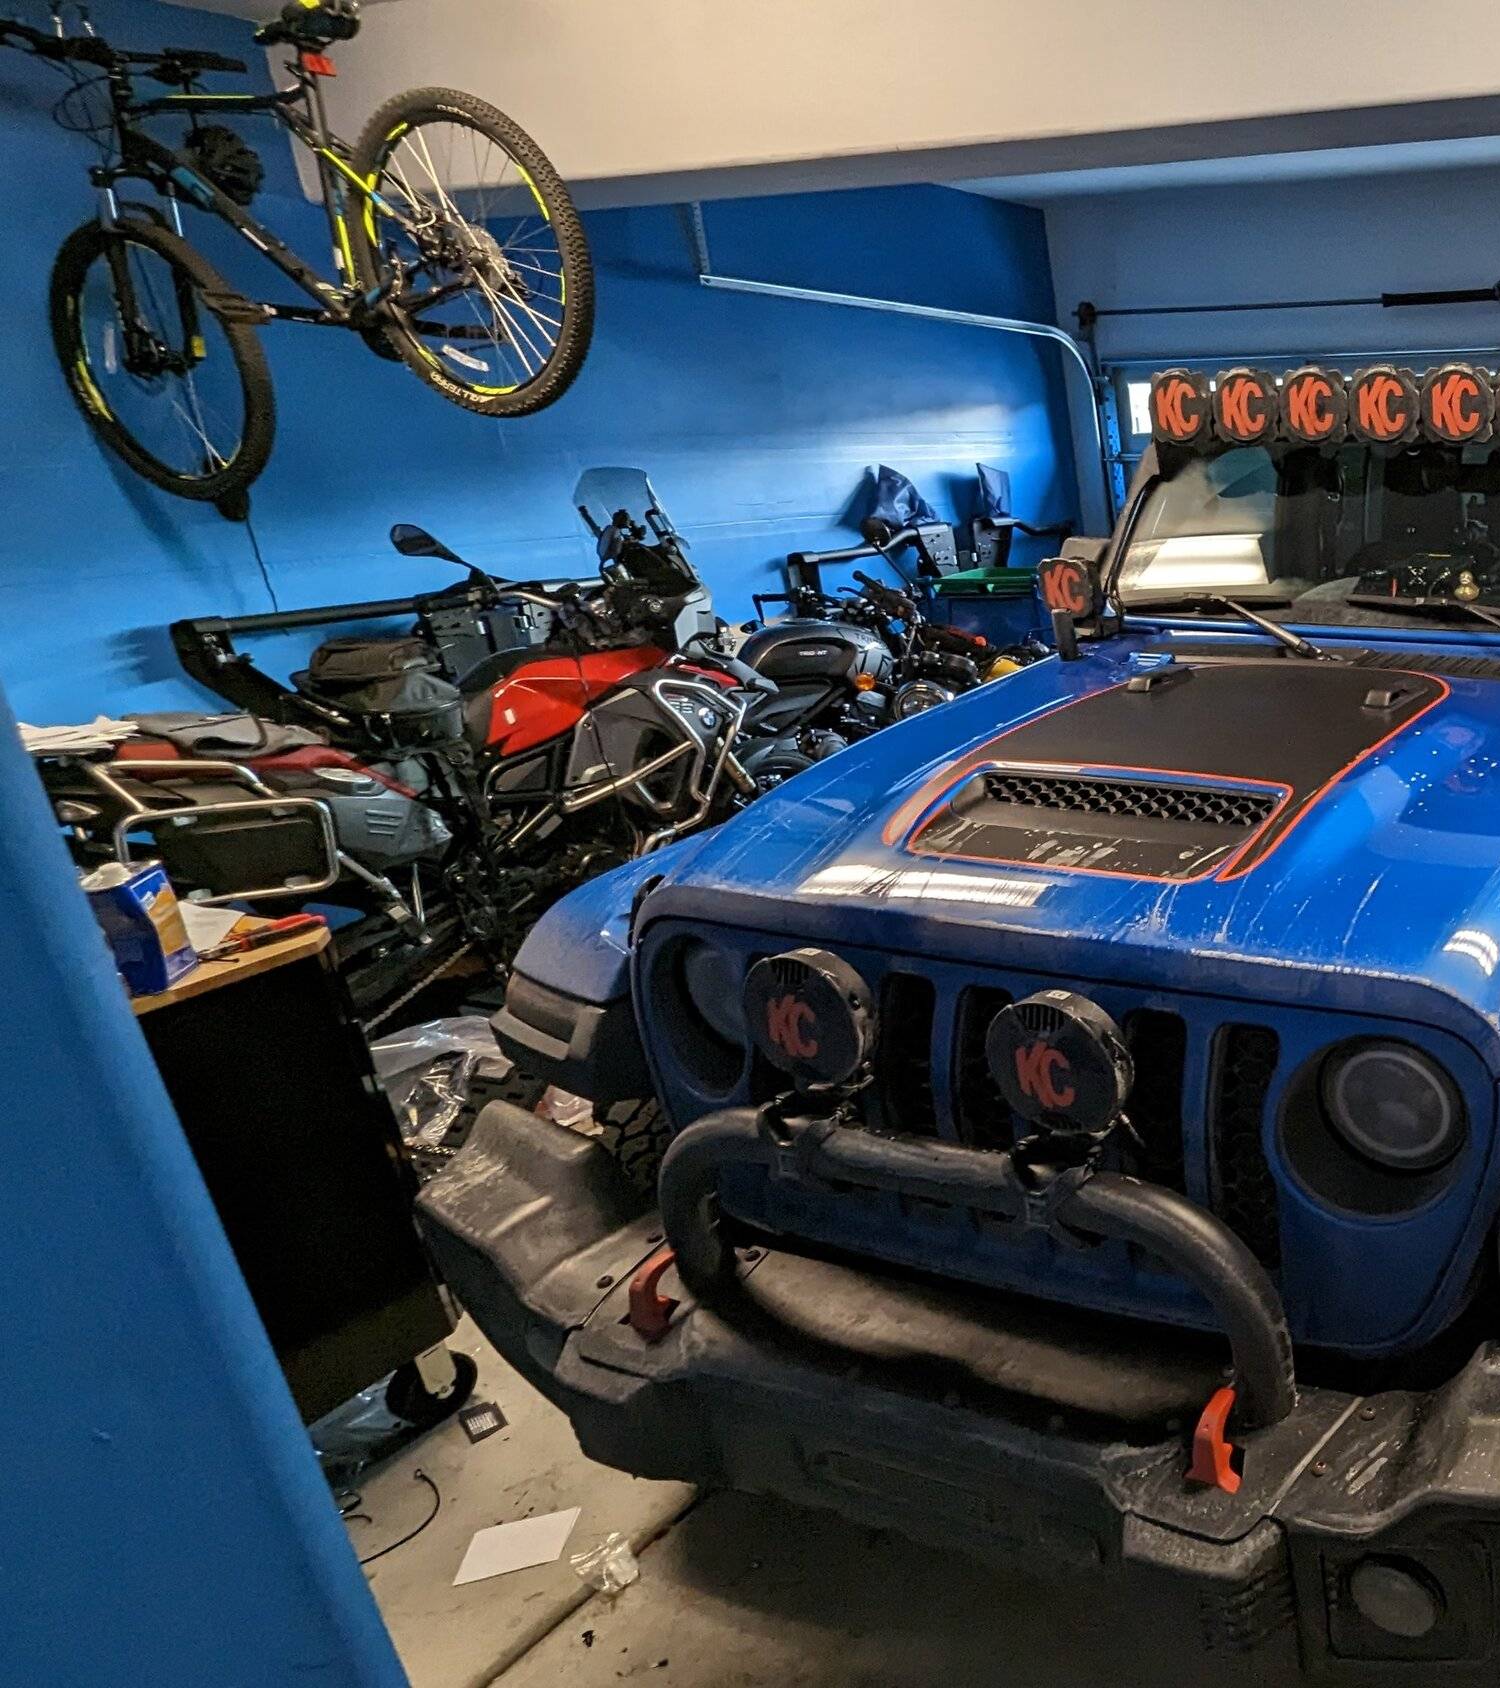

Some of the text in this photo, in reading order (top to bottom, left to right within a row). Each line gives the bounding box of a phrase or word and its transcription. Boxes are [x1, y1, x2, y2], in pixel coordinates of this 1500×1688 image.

[1155, 378, 1199, 437] KC
[1222, 377, 1265, 437] KC
[1288, 376, 1334, 436] KC
[1359, 375, 1406, 437] KC
[1431, 374, 1480, 437] KC
[1043, 563, 1085, 614] KC
[767, 994, 819, 1057] KC
[1015, 1041, 1075, 1109] KC
